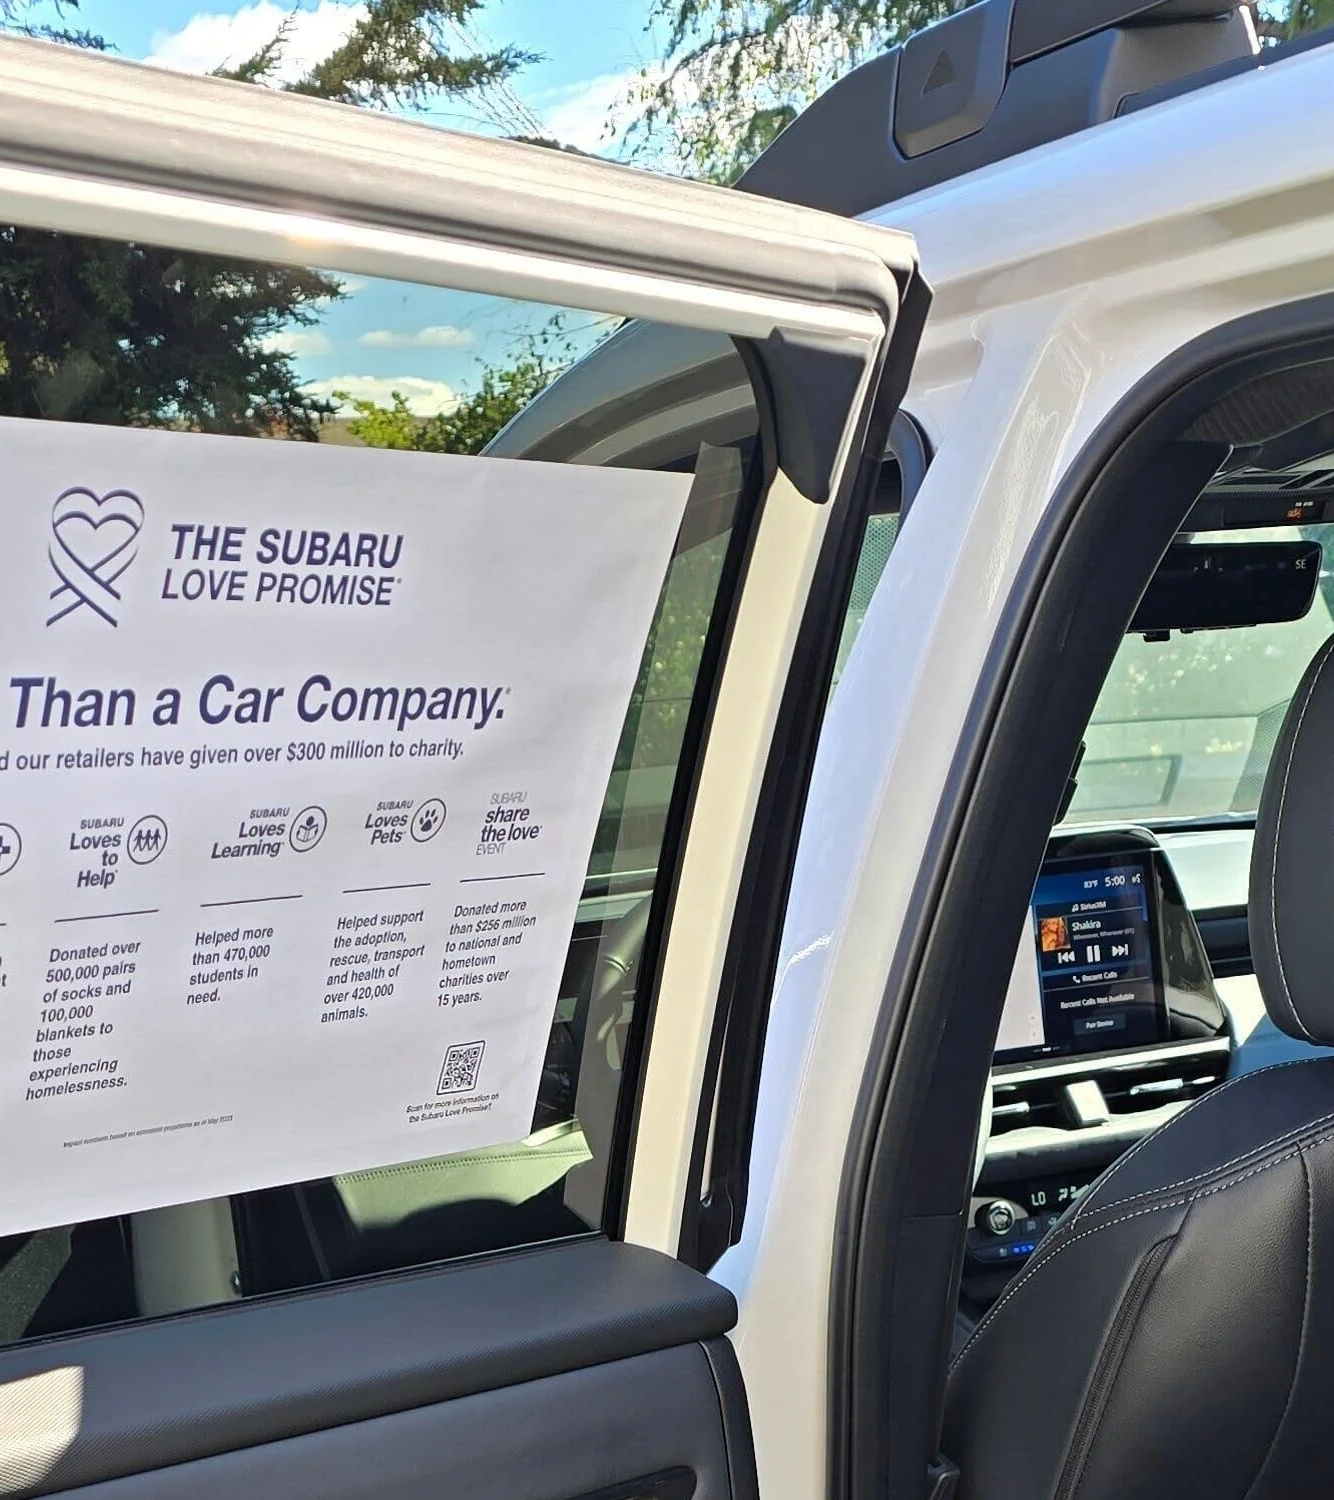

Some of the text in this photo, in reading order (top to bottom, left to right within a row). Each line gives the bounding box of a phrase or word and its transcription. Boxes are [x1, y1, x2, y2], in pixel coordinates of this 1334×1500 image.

[171, 524, 403, 568] THE SUBARU
[1296, 560, 1306, 569] SE
[161, 568, 248, 601] LOVE
[10, 677, 135, 728] Than
[152, 688, 181, 726] a
[199, 674, 285, 725] Car
[16, 754, 50, 770] our
[56, 747, 134, 769] retailers
[141, 746, 184, 766] have
[189, 744, 238, 769] given
[244, 747, 282, 763] over
[286, 741, 326, 763] $300
[330, 739, 384, 759] million
[389, 740, 404, 757] to
[409, 738, 463, 760] charity.
[364, 813, 409, 829] Loves
[485, 805, 530, 824] share
[238, 821, 286, 838] Loves
[481, 824, 506, 843] the
[69, 832, 121, 850] Loves
[101, 850, 118, 866] to
[1104, 875, 1126, 887] 5:00
[454, 901, 527, 918] Donated more
[337, 909, 424, 932] Helped support
[449, 923, 473, 935] than
[501, 915, 536, 929] million
[1072, 920, 1102, 931] Shakira
[195, 927, 274, 947] Helped more
[333, 930, 407, 948] the adoption,
[445, 932, 523, 953] to national and
[49, 942, 141, 963] Donated over
[192, 944, 270, 965] than 470,000
[329, 944, 425, 967] rescue, transport
[45, 960, 136, 984] 500,000 pairs
[442, 955, 496, 971] hometown
[189, 964, 258, 985] students in
[326, 963, 400, 986] and health of
[439, 970, 510, 988] charities over
[43, 979, 131, 1003] of socks and
[187, 988, 220, 1005] need.
[324, 983, 394, 1004] over 420,000
[438, 992, 482, 1008] 15 years.
[40, 1005, 93, 1023] 100,000
[321, 1005, 368, 1023] animals.
[36, 1022, 113, 1042] blankets to
[33, 1047, 71, 1062] those
[29, 1058, 118, 1082] experiencing
[25, 1077, 127, 1101] homelessness.
[422, 1110, 444, 1120] Subaru
[446, 1108, 460, 1116] Love
[1031, 1192, 1046, 1206] LO
